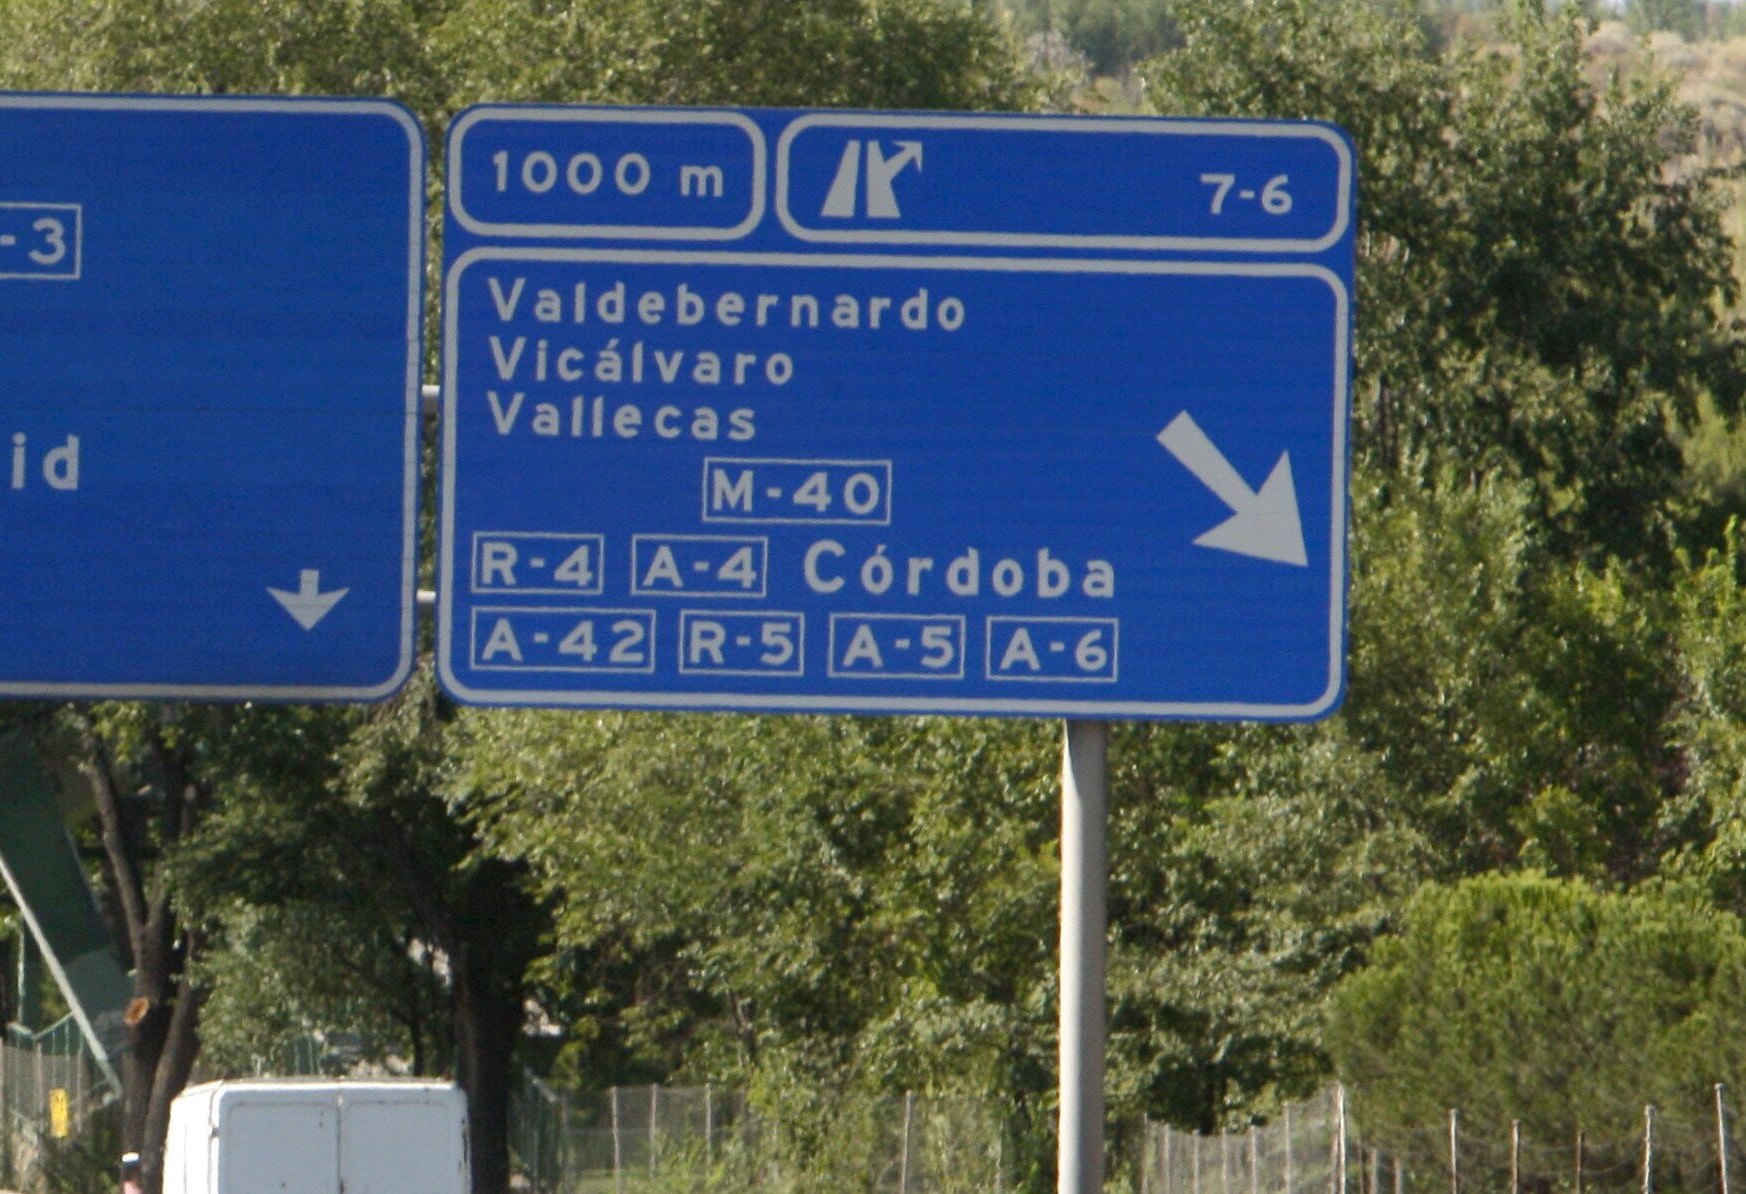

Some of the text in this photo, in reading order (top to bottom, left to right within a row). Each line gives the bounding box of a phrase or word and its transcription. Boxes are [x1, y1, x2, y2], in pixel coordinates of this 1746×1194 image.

[492, 150, 725, 199] 1000 m
[1199, 173, 1294, 216] 7-6
[486, 276, 966, 332] Valdebernardo
[488, 335, 794, 386] Vicálvaro
[486, 390, 757, 442] Vallecas
[711, 468, 881, 516] M-40
[480, 539, 1116, 599] R-4 A-4 Córdoba
[481, 617, 1109, 673] A-42 R-5 A-5 A-6
